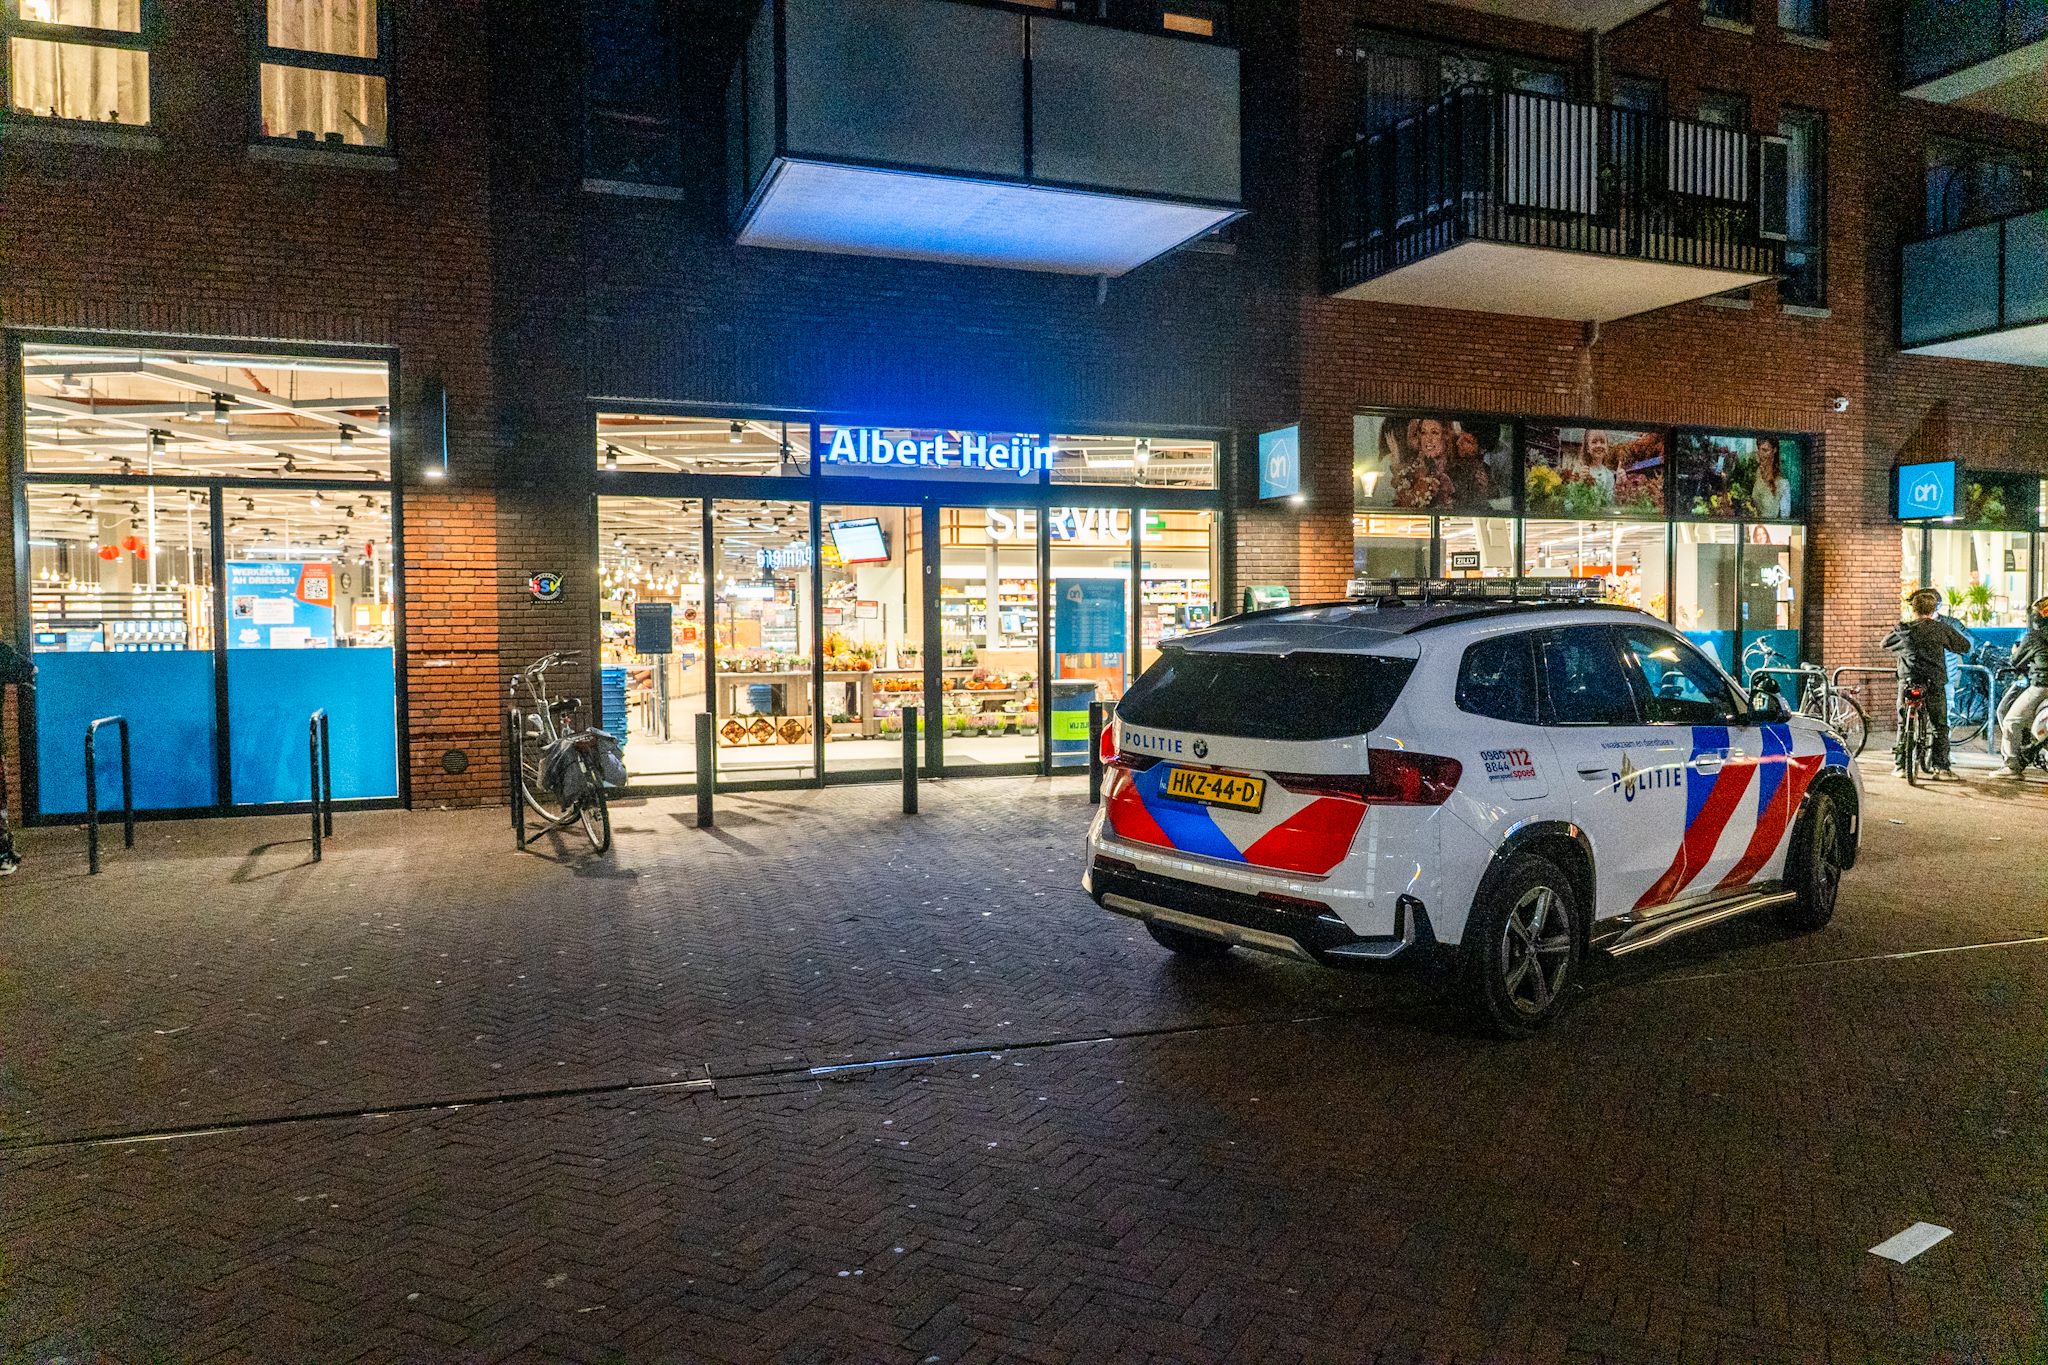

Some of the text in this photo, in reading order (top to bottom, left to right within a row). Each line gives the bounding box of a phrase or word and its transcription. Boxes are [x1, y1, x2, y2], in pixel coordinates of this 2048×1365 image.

[828, 428, 1053, 477] Albert Heijn
[984, 507, 1163, 541] SERVICE
[232, 568, 290, 576] WERKEN BIJ
[232, 577, 295, 585] AH DRIESSEN
[1125, 732, 1183, 754] POLITIE
[1485, 761, 1510, 773] 8844
[1506, 748, 1532, 766] 112
[1512, 767, 1536, 780] spoed
[1172, 772, 1255, 802] HKZ-44-D
[1611, 768, 1681, 802] POLITIE
